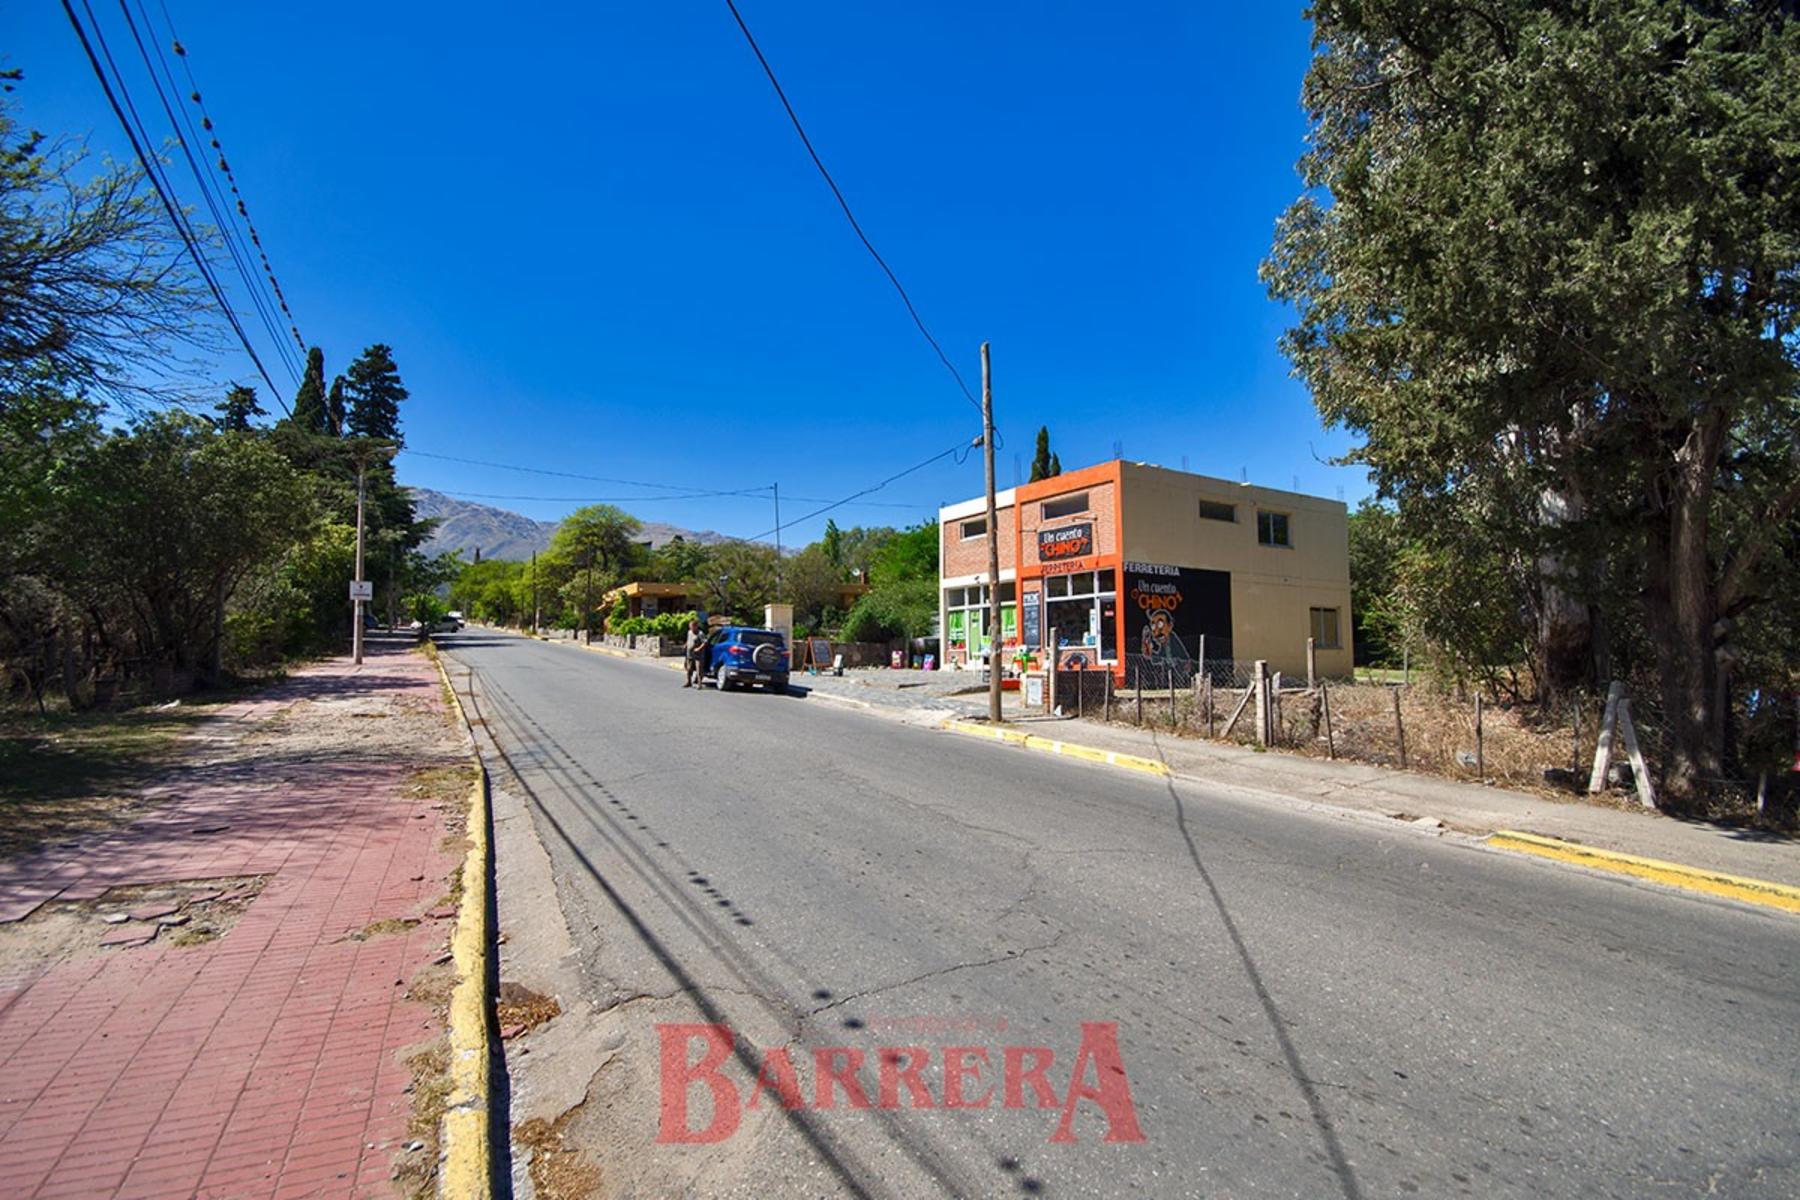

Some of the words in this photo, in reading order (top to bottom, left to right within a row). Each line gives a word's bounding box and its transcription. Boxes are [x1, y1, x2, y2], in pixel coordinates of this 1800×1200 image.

[1055, 527, 1083, 542] cuento
[1124, 561, 1180, 576] FERRETERIA
[1138, 580, 1150, 593] Un
[1150, 582, 1177, 595] cuento
